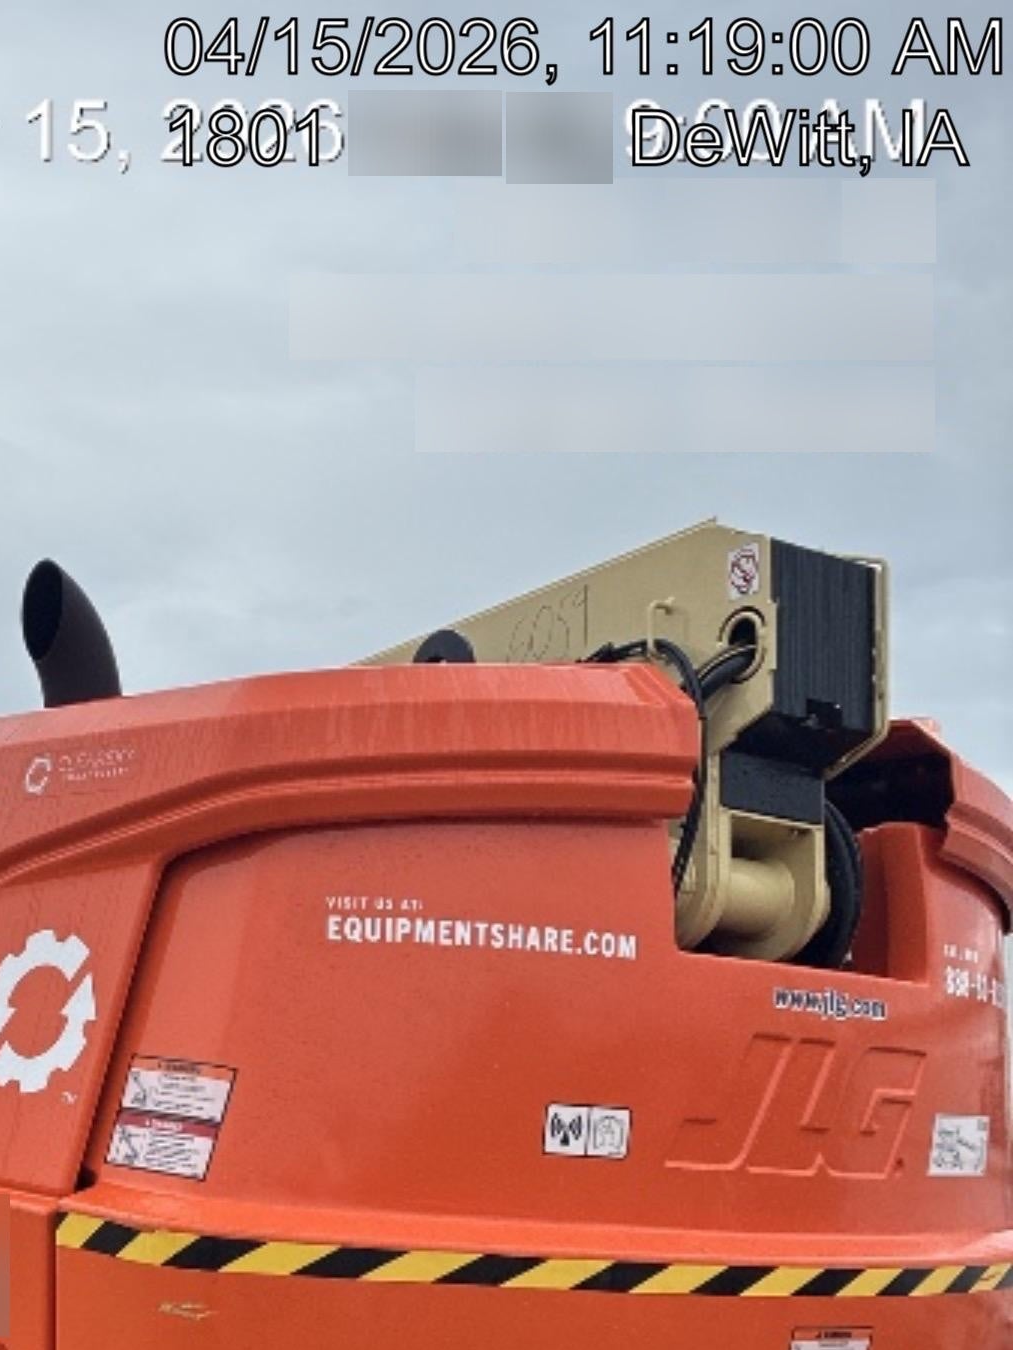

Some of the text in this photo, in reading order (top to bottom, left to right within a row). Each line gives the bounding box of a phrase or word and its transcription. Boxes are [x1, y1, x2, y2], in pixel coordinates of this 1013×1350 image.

[326, 895, 369, 911] VISIT
[326, 914, 638, 961] EQUIPMENTSHARE.COM
[773, 987, 887, 1020] www.jlg.com
